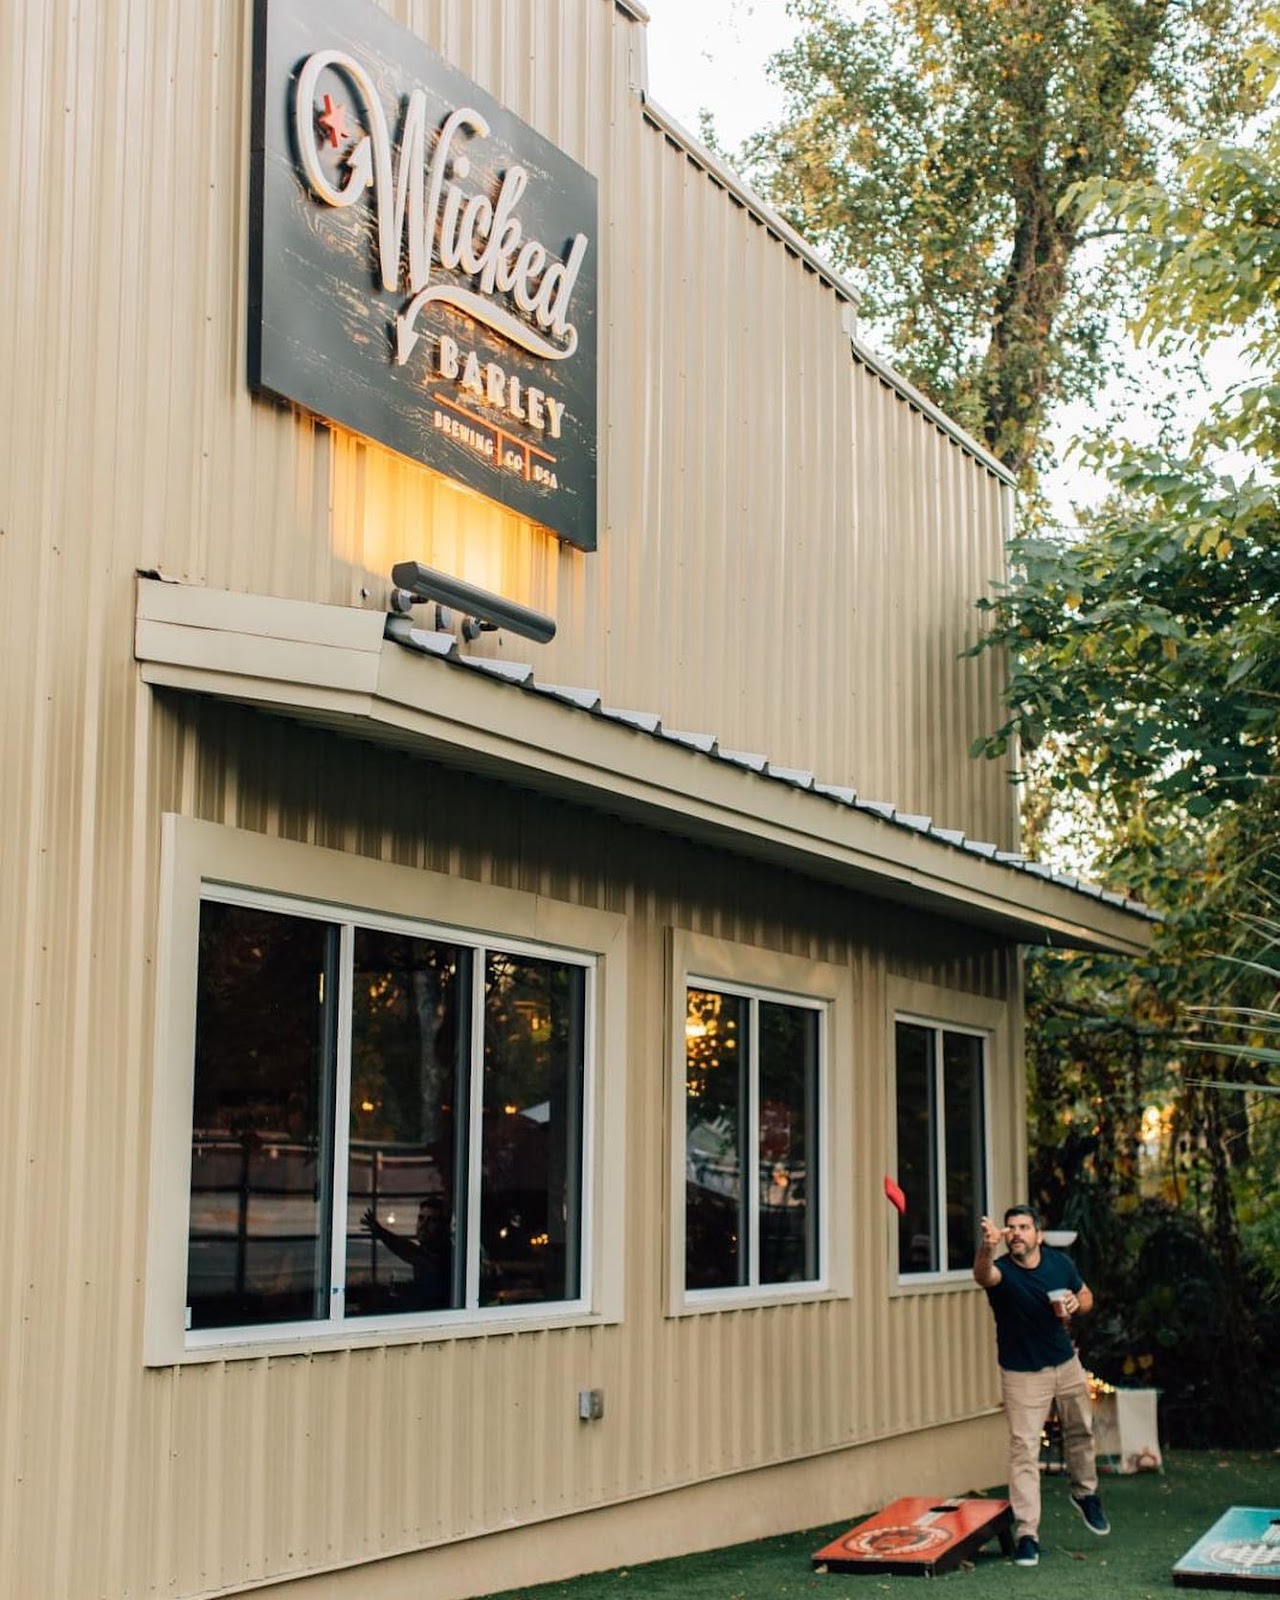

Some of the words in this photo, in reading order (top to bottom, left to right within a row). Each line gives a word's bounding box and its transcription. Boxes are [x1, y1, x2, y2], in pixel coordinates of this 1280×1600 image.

[296, 49, 588, 363] Wicked
[438, 335, 565, 438] BARLEY
[433, 410, 494, 455] BREWING
[503, 450, 523, 470] CO
[533, 464, 559, 489] USA
